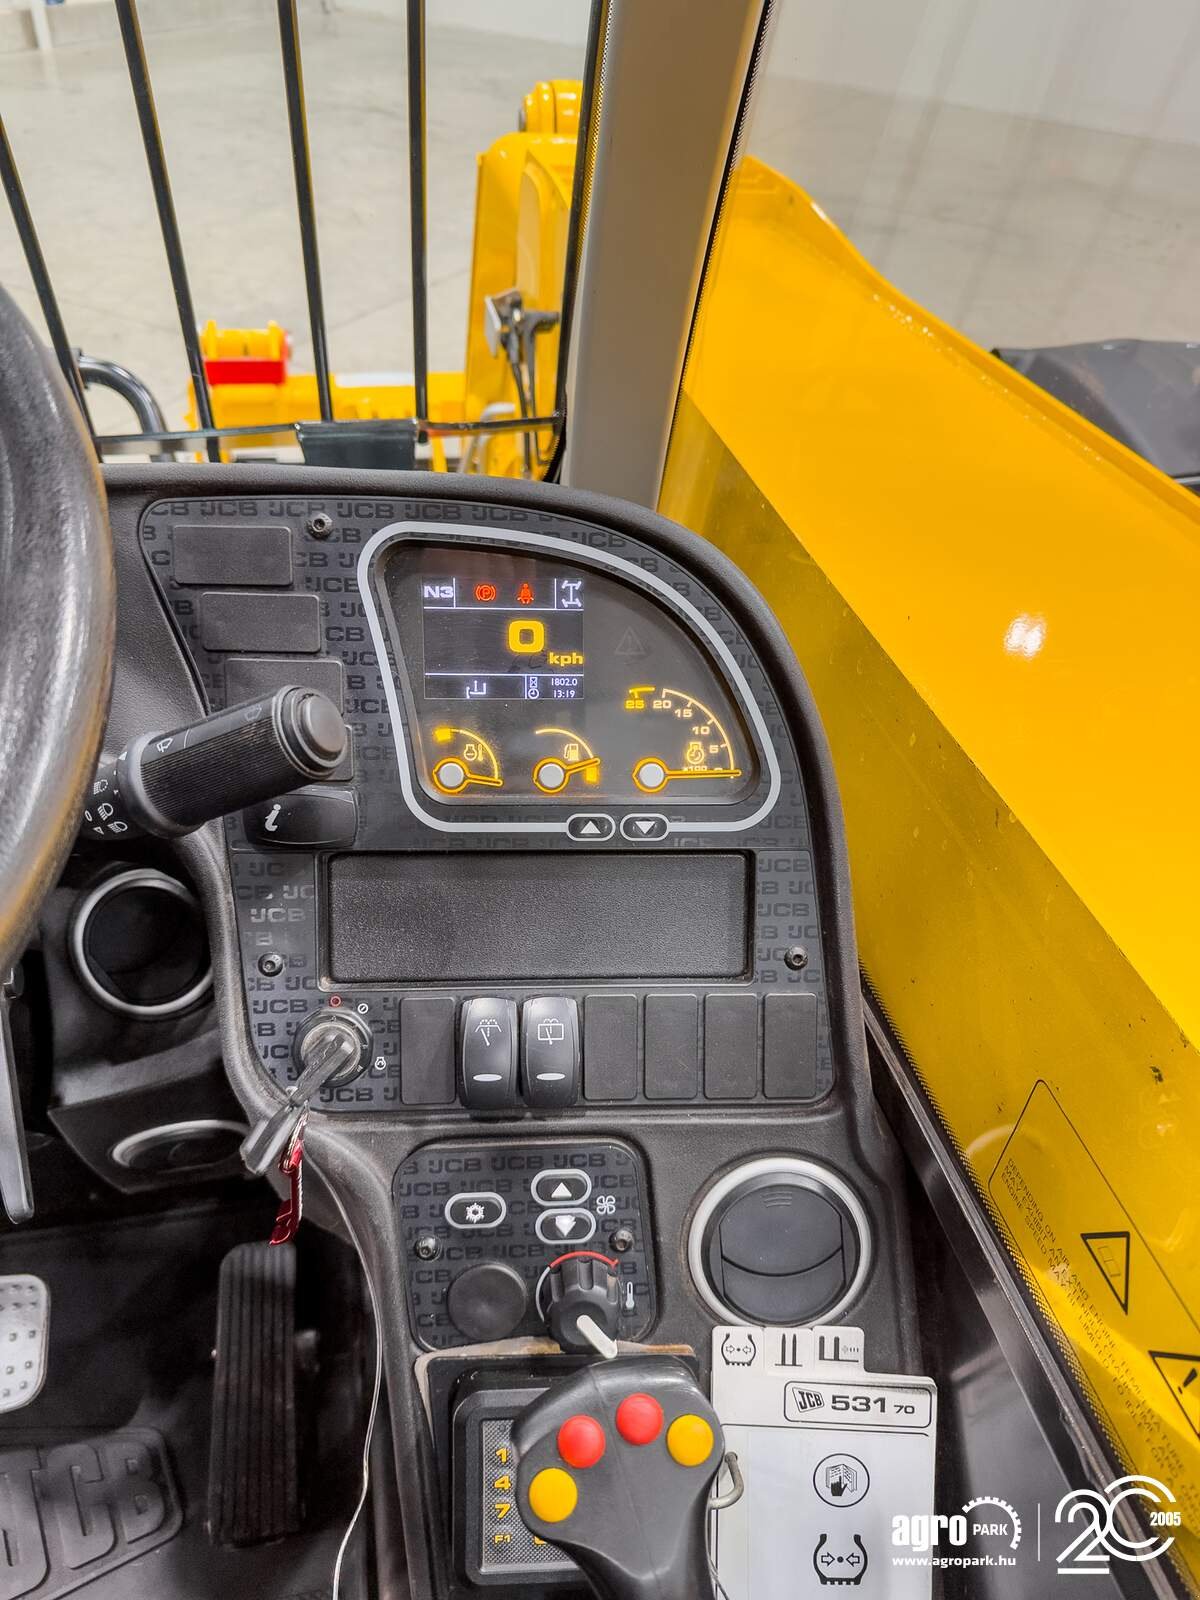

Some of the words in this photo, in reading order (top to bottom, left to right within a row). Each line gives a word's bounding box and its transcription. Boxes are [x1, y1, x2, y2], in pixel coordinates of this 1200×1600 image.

[201, 502, 258, 517] JCB
[337, 503, 394, 519] JCB
[405, 504, 461, 520] JCB
[424, 585, 454, 598] N3
[508, 620, 545, 653] 0
[549, 652, 584, 667] kph
[551, 678, 578, 686] 1802.0
[553, 690, 575, 698] 13:19
[625, 699, 645, 709] 25
[652, 700, 671, 709] 20
[674, 709, 693, 718] 15
[692, 726, 710, 735] 10
[709, 745, 719, 754] 5
[758, 858, 810, 872] JCB
[250, 908, 306, 922] JCB
[758, 903, 810, 917] JCB
[253, 1000, 308, 1014] JCB
[320, 1088, 373, 1102] JCB
[428, 1158, 481, 1174] JCB
[491, 1155, 544, 1172] JCB
[553, 1153, 606, 1169] JCB
[798, 1390, 822, 1410] JCB
[830, 1395, 887, 1413] 531
[894, 1404, 915, 1415] 70
[496, 1447, 511, 1464] 1
[494, 1475, 511, 1492] 4
[495, 1502, 510, 1518] 7
[494, 1533, 511, 1544] F1
